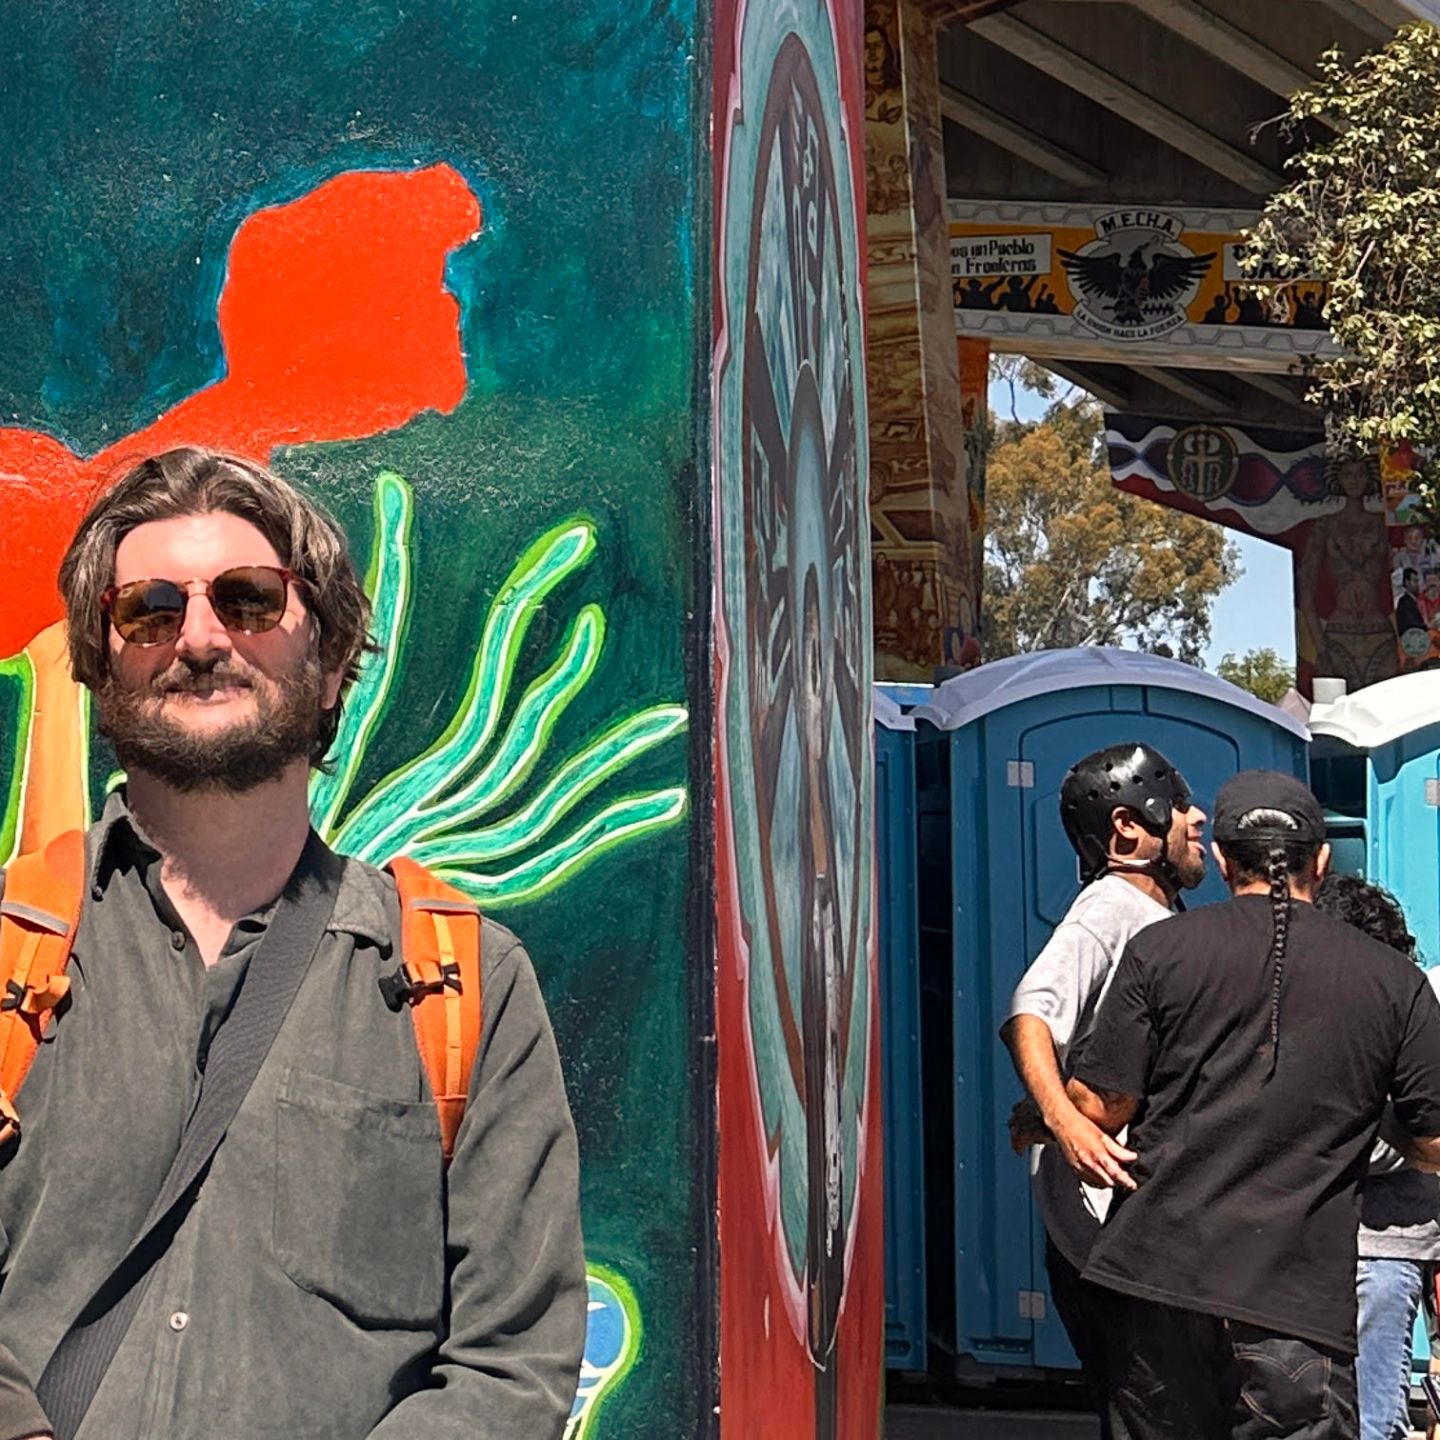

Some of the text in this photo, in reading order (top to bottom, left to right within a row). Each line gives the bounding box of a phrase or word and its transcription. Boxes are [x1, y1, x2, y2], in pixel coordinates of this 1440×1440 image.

[971, 244, 987, 257] un
[989, 238, 1034, 256] Pueblo
[966, 257, 1036, 274] Fronteras
[1137, 328, 1148, 337] LA
